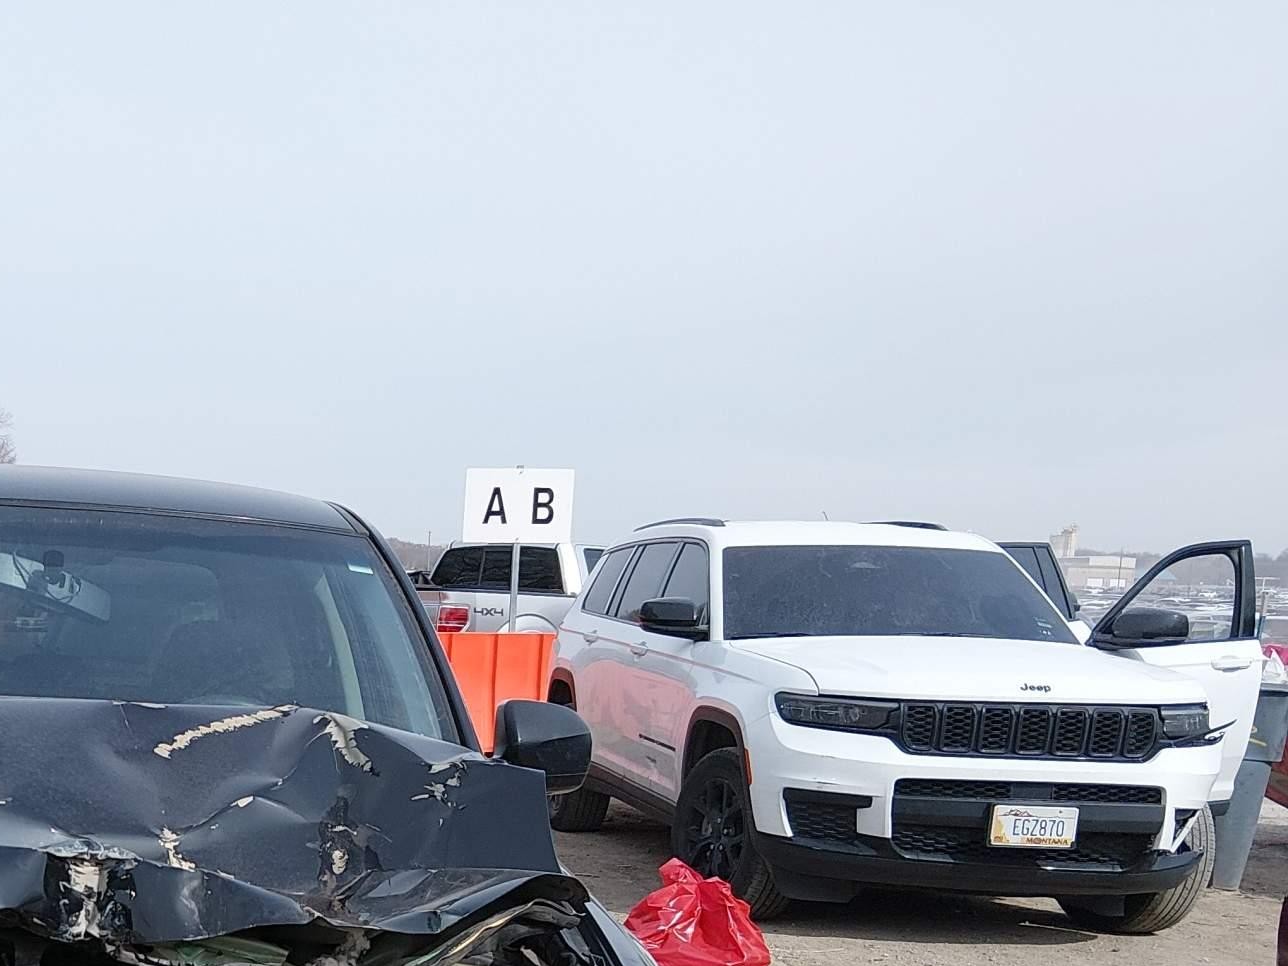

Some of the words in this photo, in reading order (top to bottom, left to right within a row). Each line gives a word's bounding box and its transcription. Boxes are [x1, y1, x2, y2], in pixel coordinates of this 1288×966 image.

[482, 487, 507, 524] A
[531, 487, 554, 524] B
[1020, 683, 1051, 693] Jeep
[1012, 819, 1065, 837] EGZ870
[1026, 837, 1068, 845] MONTANA
